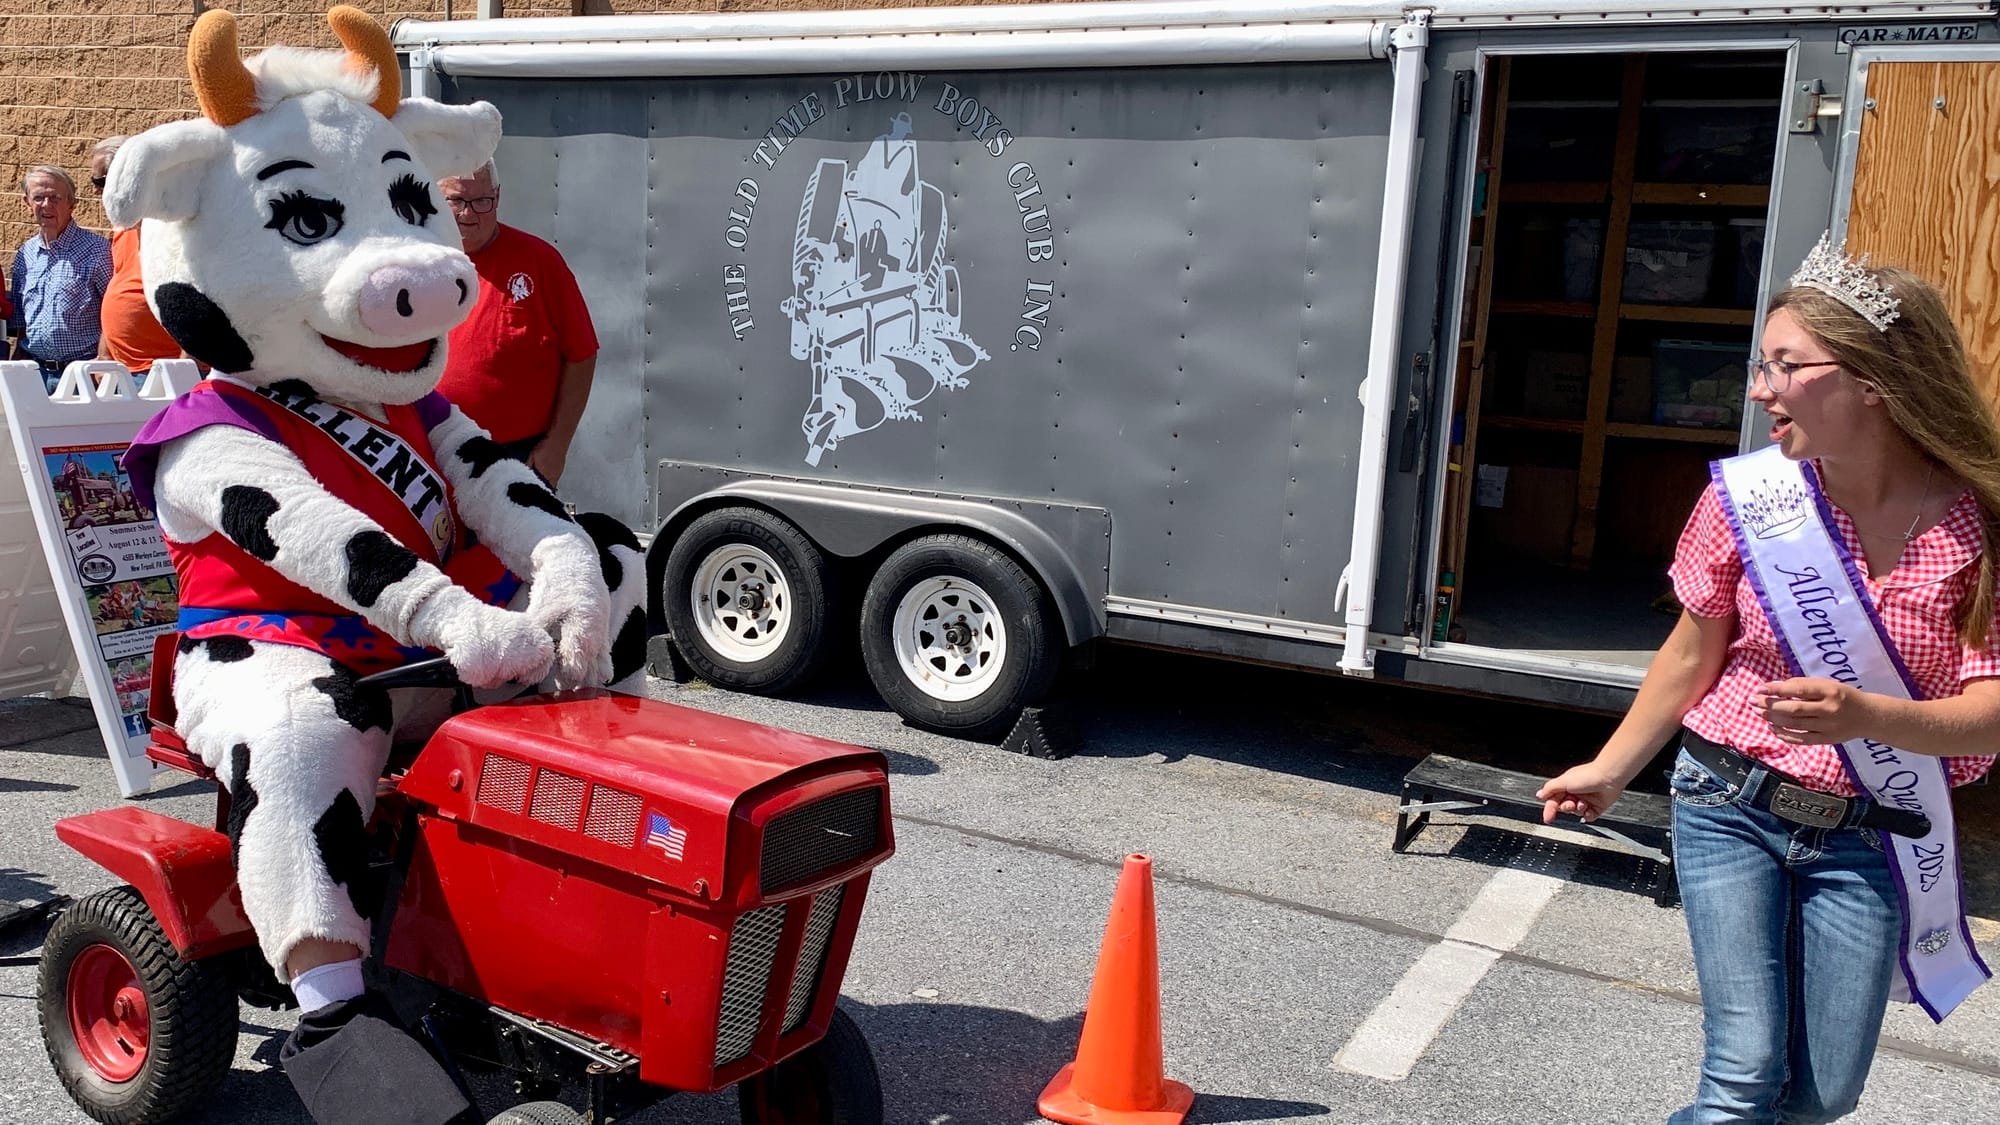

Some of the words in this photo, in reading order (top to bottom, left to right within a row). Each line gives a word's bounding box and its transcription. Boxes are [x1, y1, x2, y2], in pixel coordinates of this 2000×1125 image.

[1906, 25, 1975, 41] MATE
[832, 70, 928, 110] PLOW
[934, 81, 1015, 158] BOYS
[751, 91, 826, 171] TIME
[723, 176, 761, 249] OLD
[1005, 160, 1055, 264] CLUB
[723, 263, 756, 341] THE
[1008, 278, 1055, 354] INC.
[107, 540, 131, 550] August
[132, 538, 140, 546] 12
[141, 537, 148, 545] &
[148, 536, 157, 544] 13
[108, 525, 137, 536] Summer
[1774, 564, 1863, 689] Allentow
[1877, 770, 1927, 819] Que
[1911, 843, 1945, 893] 2023
[1775, 796, 1824, 816] CASE
